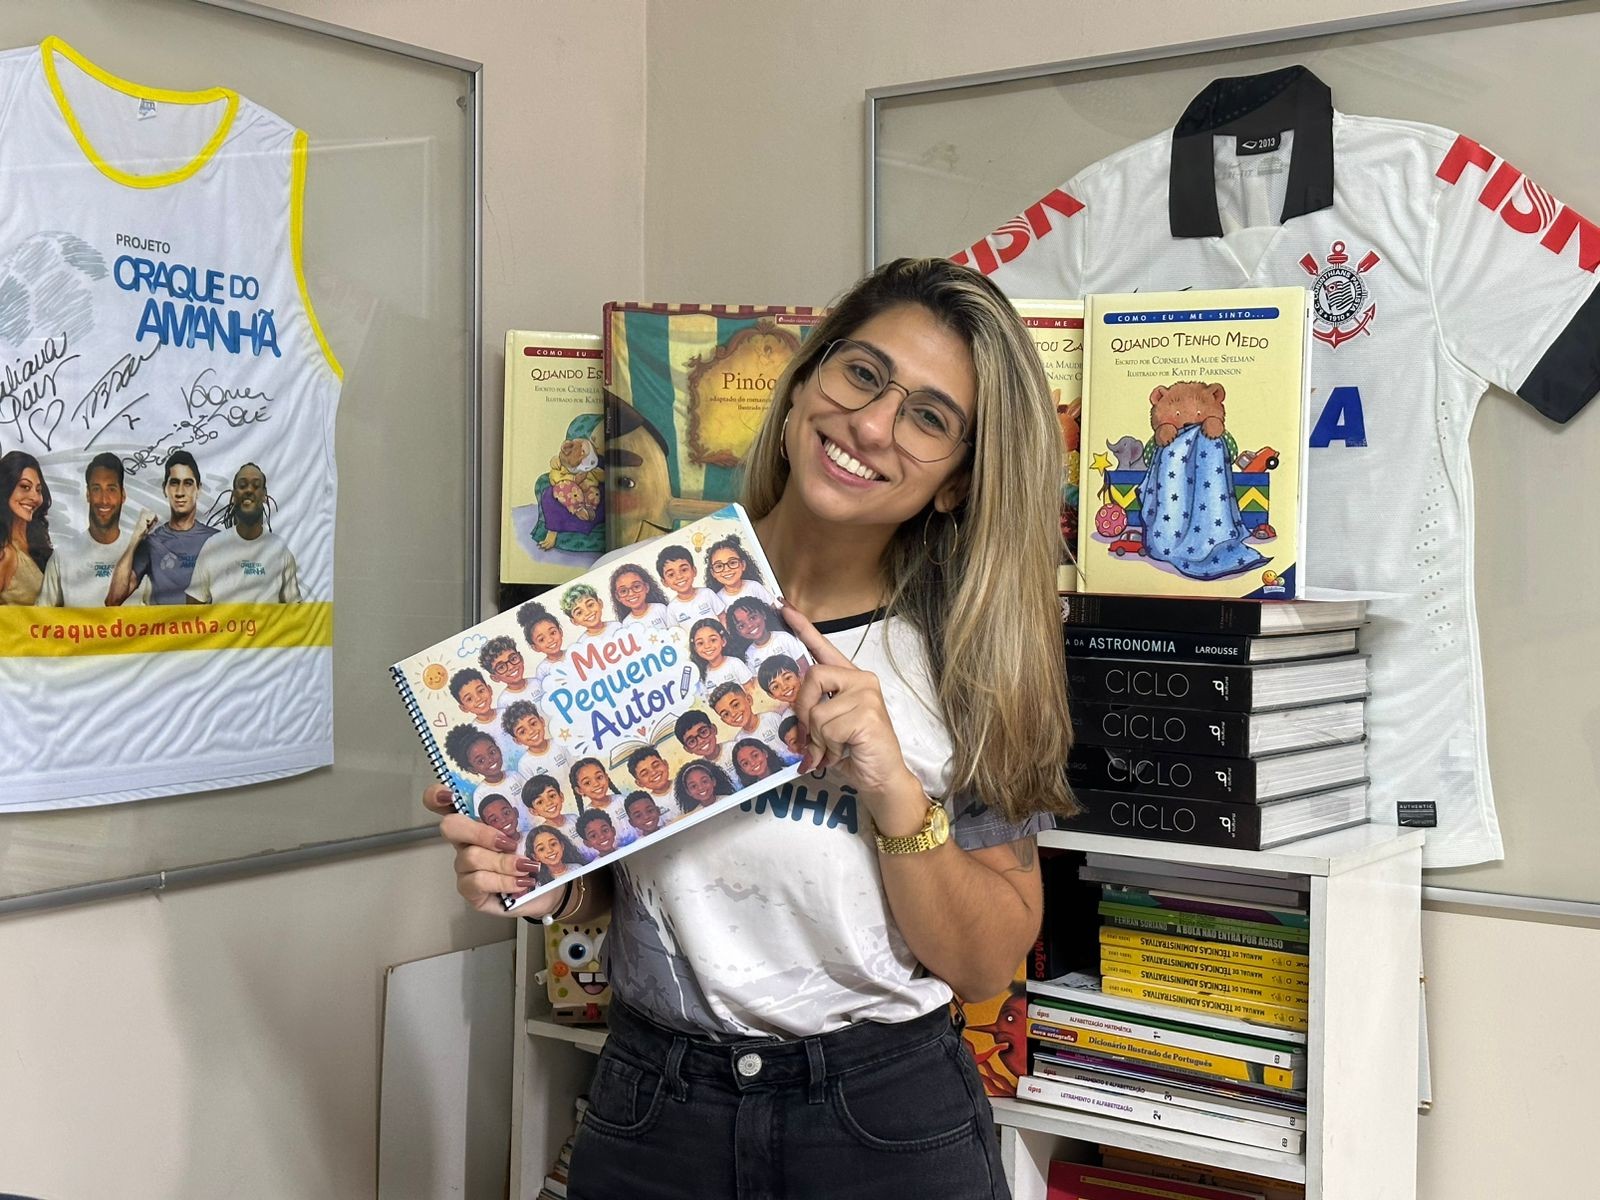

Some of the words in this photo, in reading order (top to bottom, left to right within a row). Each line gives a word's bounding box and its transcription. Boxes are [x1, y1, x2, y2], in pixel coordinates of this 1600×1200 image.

[1258, 137, 1276, 149] 2013
[116, 234, 171, 254] PROJETO
[114, 255, 225, 305] CRAQUE
[230, 274, 259, 300] DO
[1118, 314, 1147, 322] COMO
[1190, 312, 1203, 320] ME
[136, 298, 281, 358] AMANHÃ
[1111, 336, 1170, 353] QUANDO
[1173, 333, 1221, 348] TENHO
[1225, 332, 1269, 349] MEDO
[532, 368, 584, 381] QUANDO
[30, 618, 257, 643] craquedoamanha.org
[1089, 637, 1176, 653] ASTRONOMIA
[1195, 646, 1238, 656] LAROUSSE
[570, 633, 642, 681] Meu
[548, 640, 679, 725] Pequeno
[1106, 670, 1190, 697] CICLO
[591, 679, 677, 750] Autor
[1102, 713, 1186, 741] CICLO
[1107, 757, 1192, 787] CICLO
[1110, 802, 1196, 832] CICLO
[1114, 916, 1139, 927] FERRAN
[1140, 937, 1199, 954] ADMINISTRATIVAS
[1176, 926, 1181, 934] A
[1183, 926, 1201, 936] BOLA
[1218, 932, 1241, 943] ENTRA
[1242, 935, 1257, 944] POR
[1258, 937, 1284, 949] ACASO
[1200, 947, 1231, 960] TÉCNICAS
[1241, 952, 1263, 961] MANUAL
[1141, 954, 1199, 971] ADMINISTRATIVAS
[1200, 964, 1231, 978] TÉCNICAS
[1141, 971, 1199, 988] ADMINISTRATIVAS
[1241, 970, 1263, 979] MANUAL
[1200, 981, 1231, 994] TÉCNICAS
[1240, 987, 1262, 996] MANUAL
[1143, 990, 1200, 1007] ADMINISTRATIVAS
[1202, 1000, 1233, 1013] TÉCNICAS
[1243, 1007, 1265, 1016] MANUAL
[1070, 1016, 1104, 1029] ALFABETIZAÇÃO
[1104, 1022, 1132, 1034] MATEMÁTICA
[1047, 1032, 1075, 1042] ortografia
[1089, 1036, 1127, 1051] Dicionário
[1127, 1044, 1162, 1058] Ilustrado
[1162, 1051, 1171, 1059] de
[1172, 1053, 1213, 1068] Português
[1075, 1074, 1105, 1085] LETRAMENTO
[1109, 1081, 1146, 1094] ALFABETIZAÇÃO
[1060, 1092, 1091, 1104] LETRAMENTO
[1096, 1100, 1134, 1113] ALFABETIZAÇÃO
